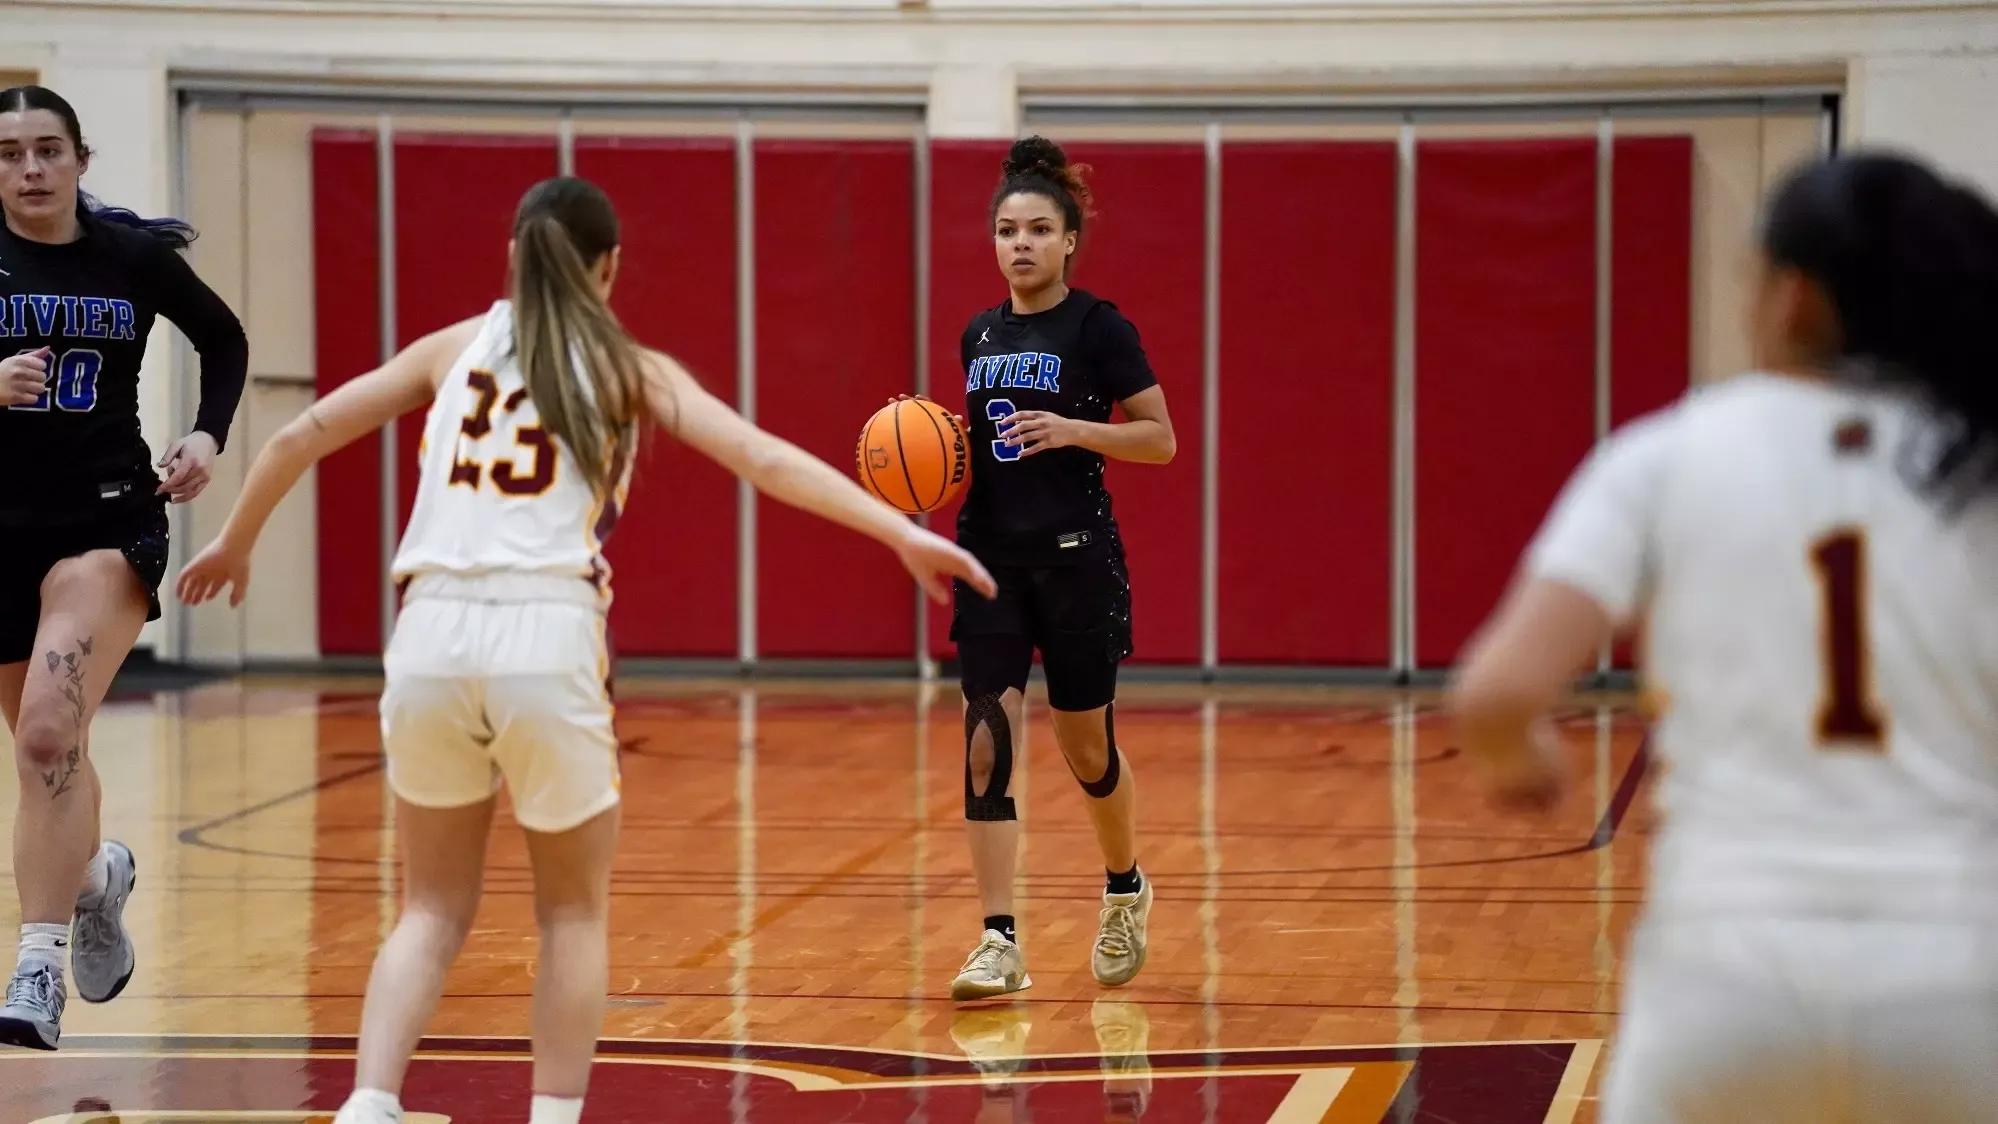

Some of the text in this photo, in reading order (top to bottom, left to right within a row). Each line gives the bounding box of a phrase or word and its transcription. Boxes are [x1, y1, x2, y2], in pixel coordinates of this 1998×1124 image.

[447, 369, 559, 497] 23
[986, 399, 1025, 462] 3
[1082, 534, 1088, 542] S
[1804, 523, 1889, 755] 1
